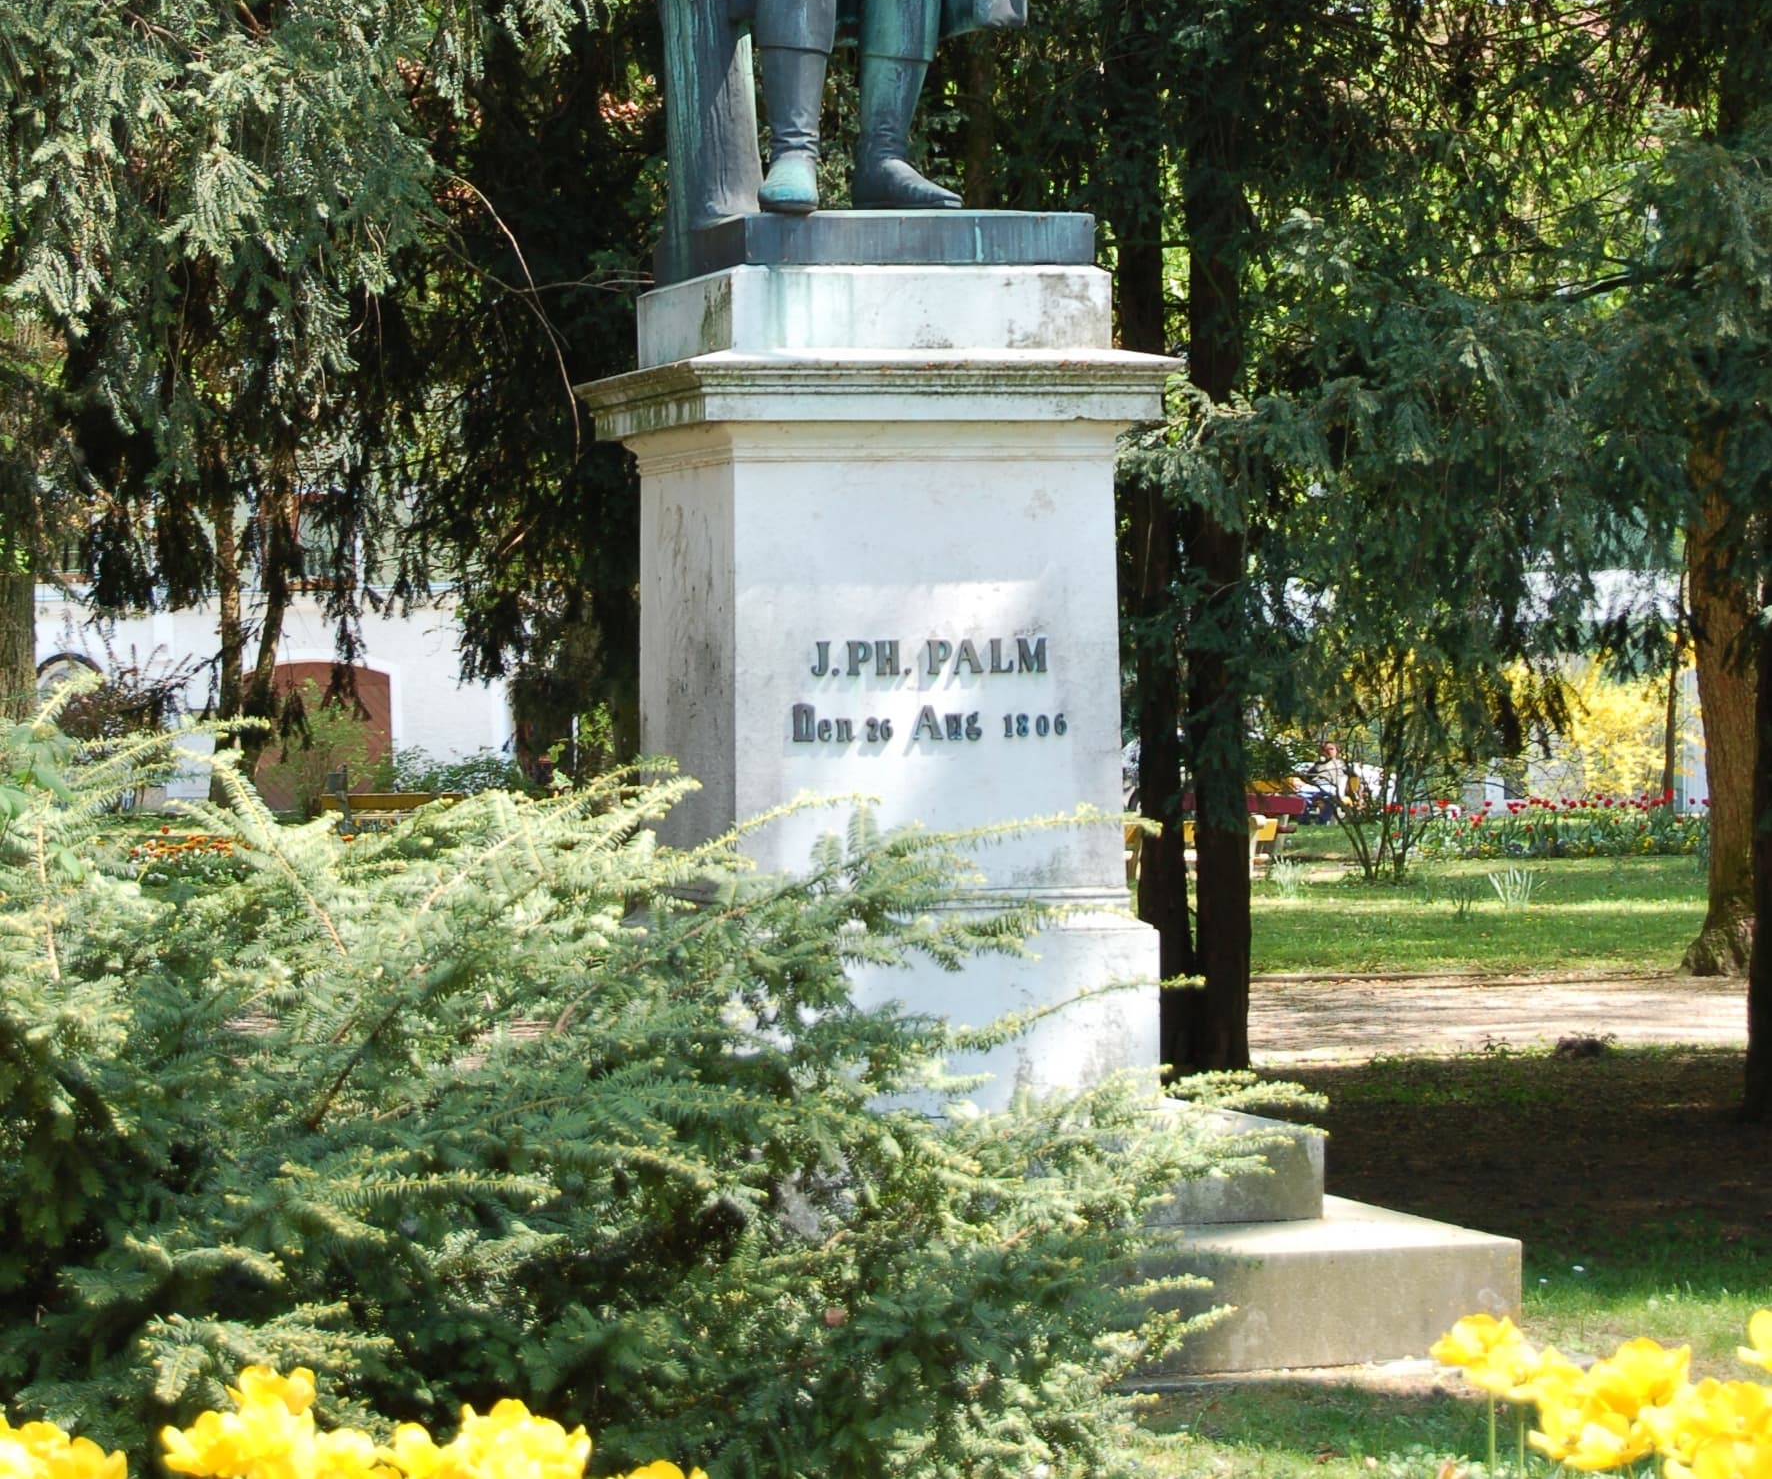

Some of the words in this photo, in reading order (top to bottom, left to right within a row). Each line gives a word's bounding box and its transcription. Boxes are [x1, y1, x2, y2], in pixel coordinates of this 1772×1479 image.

[927, 638, 1048, 675] PALM
[792, 703, 855, 743] Den
[866, 717, 893, 742] 26
[913, 705, 983, 741] Aug
[1002, 713, 1067, 738] 1806
